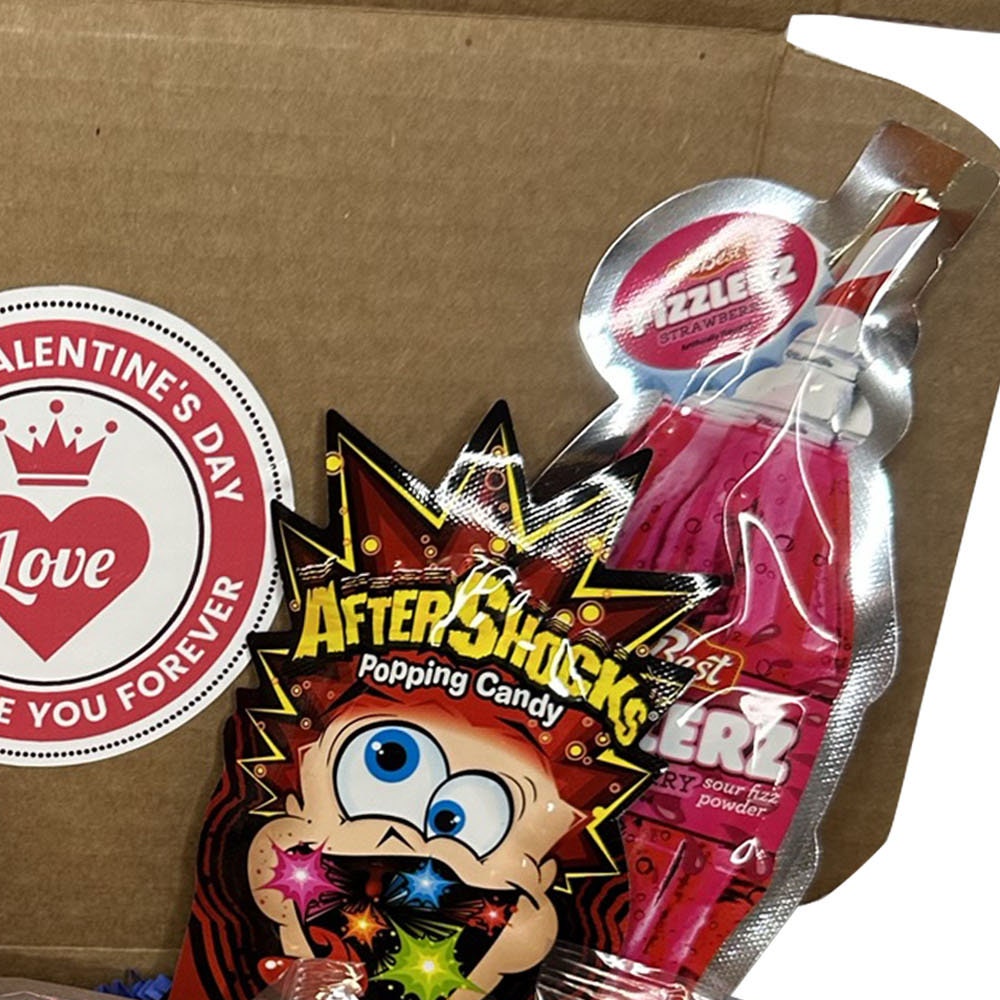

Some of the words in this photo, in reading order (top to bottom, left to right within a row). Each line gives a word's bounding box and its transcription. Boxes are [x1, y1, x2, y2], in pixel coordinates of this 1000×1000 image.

[633, 254, 797, 338] IZZLEZ
[659, 302, 762, 345] STRAWBERR
[193, 423, 245, 503] DAY
[29, 694, 108, 728] YOU
[116, 575, 244, 712] FOREVER
[359, 654, 470, 697] Popping
[476, 672, 563, 726] Candy
[640, 702, 797, 784] ERZ
[703, 778, 745, 796] sour
